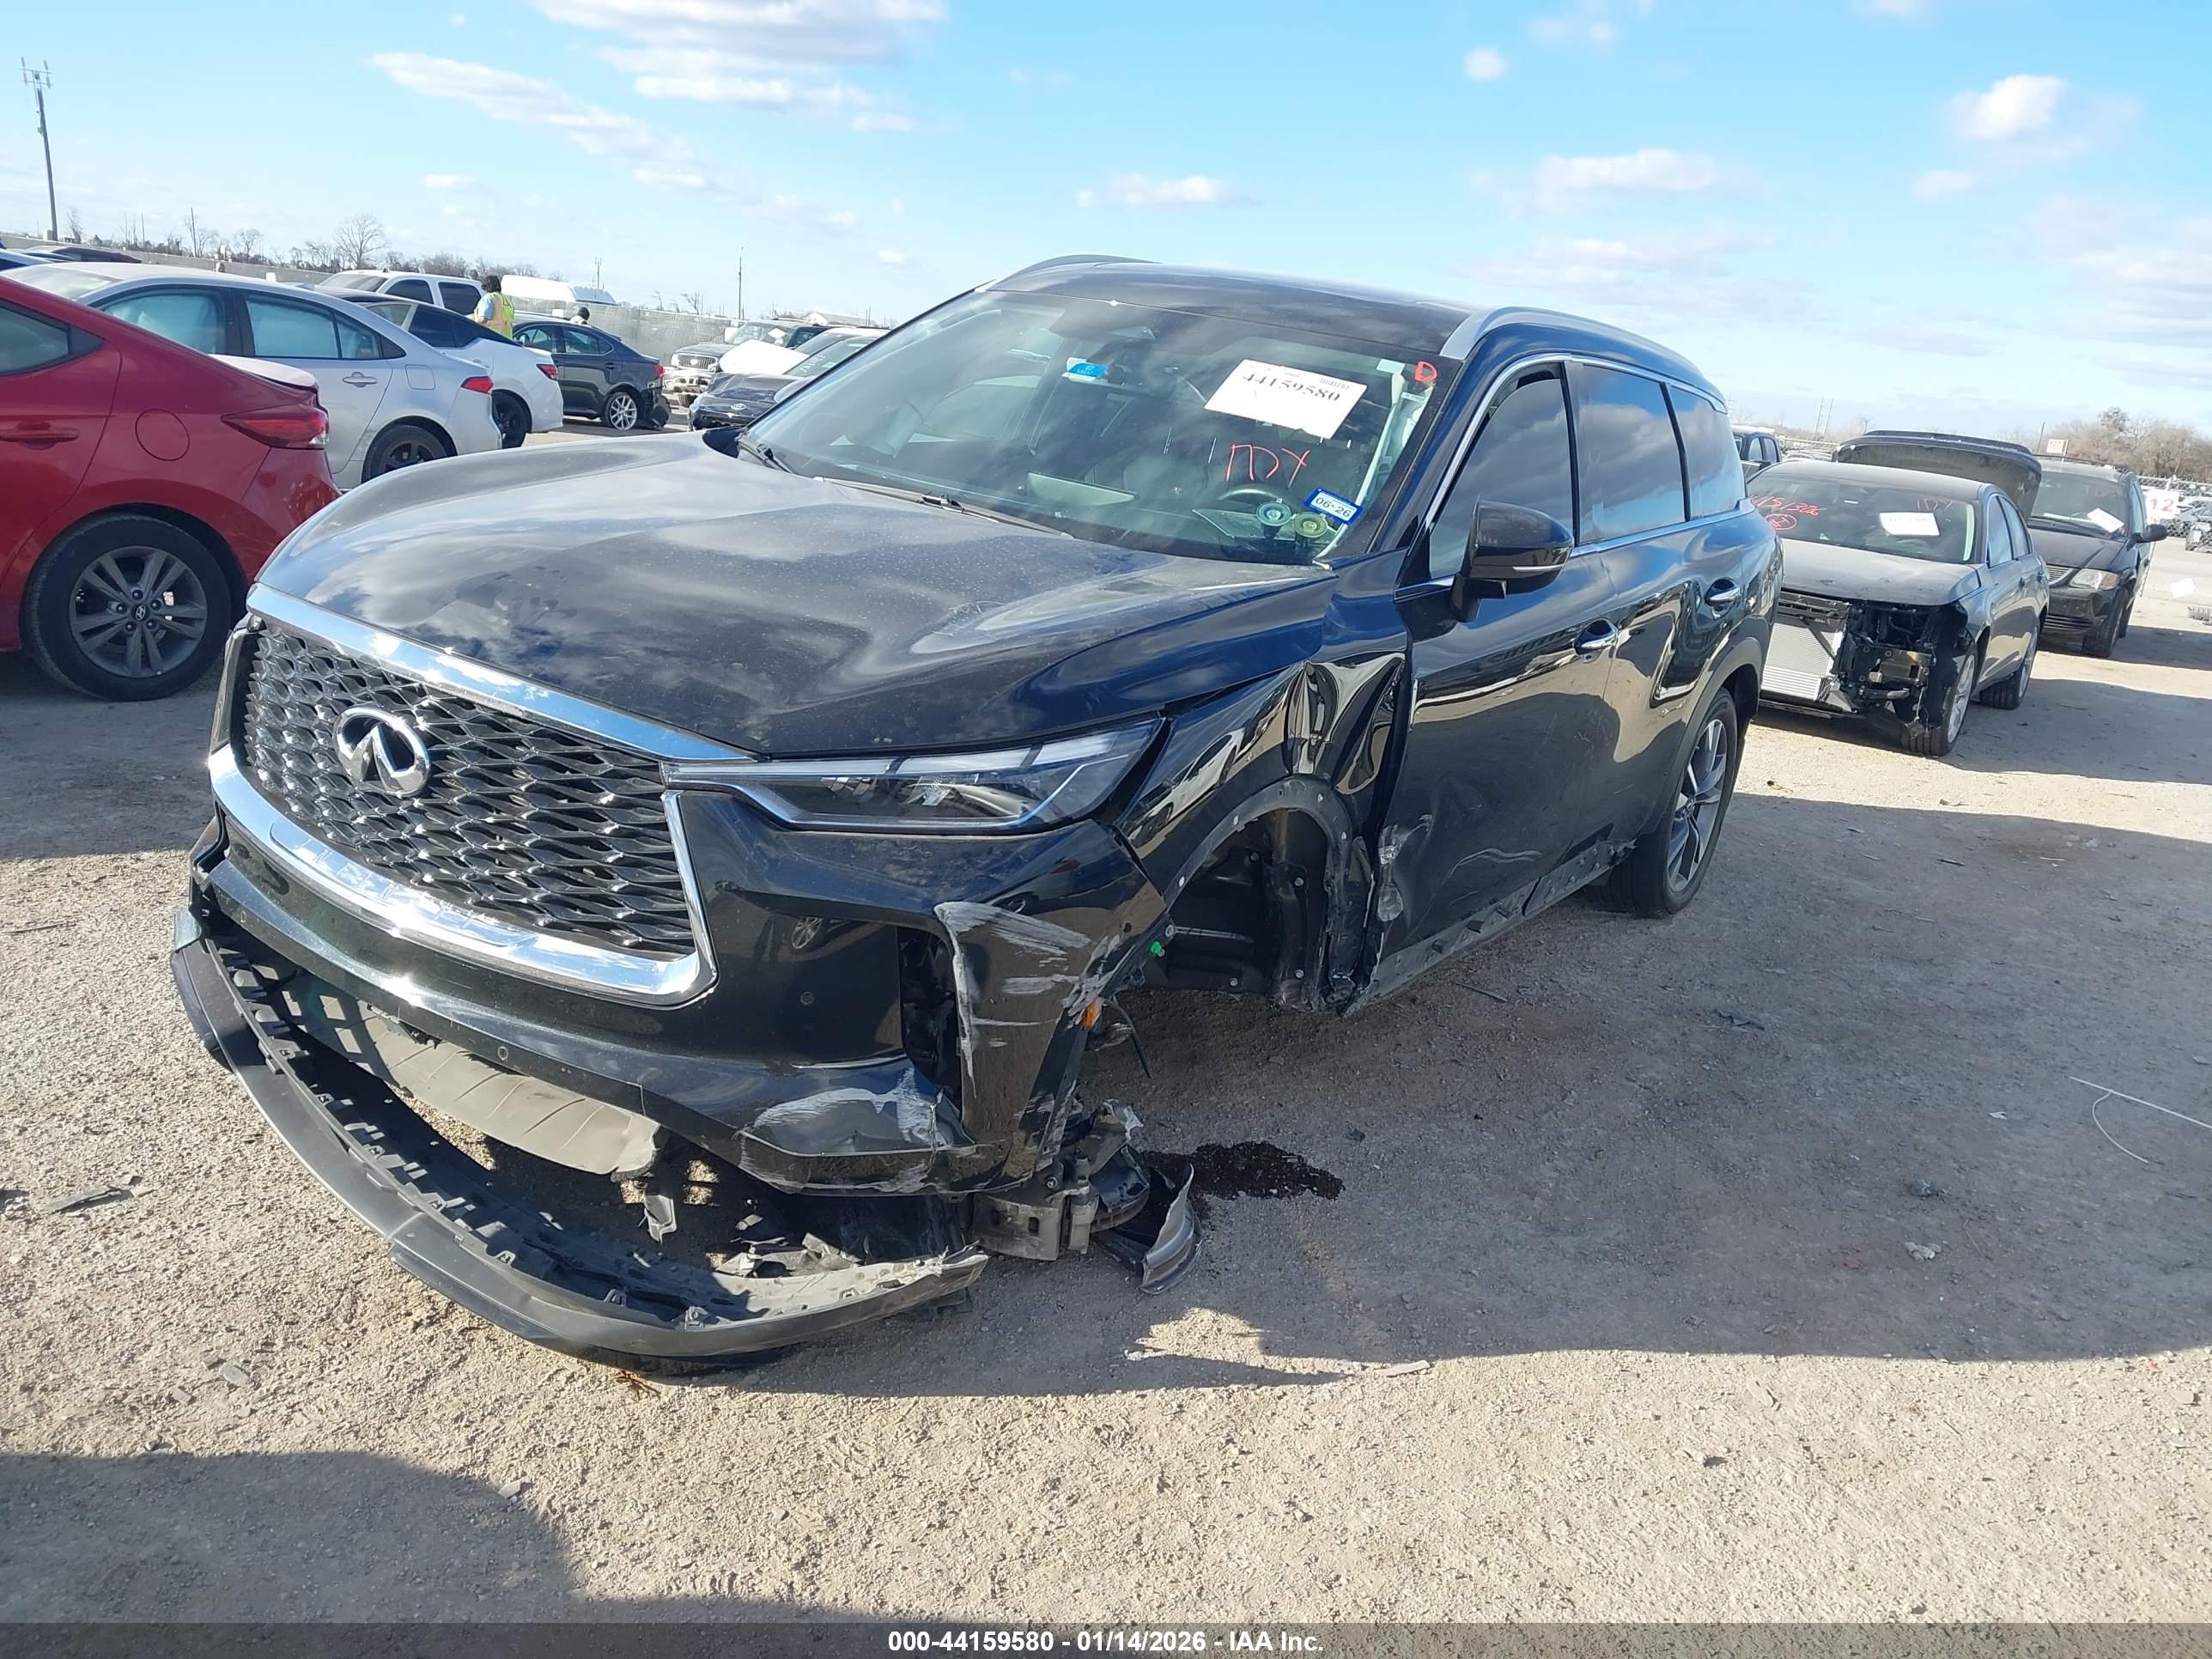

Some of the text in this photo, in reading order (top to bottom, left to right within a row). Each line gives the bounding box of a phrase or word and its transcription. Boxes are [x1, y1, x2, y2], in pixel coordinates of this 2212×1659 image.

[1414, 361, 1438, 384] D
[1242, 372, 1340, 403] 44159580
[1315, 496, 1331, 509] 06
[1334, 505, 1352, 519] 26
[2149, 497, 2175, 513] 12
